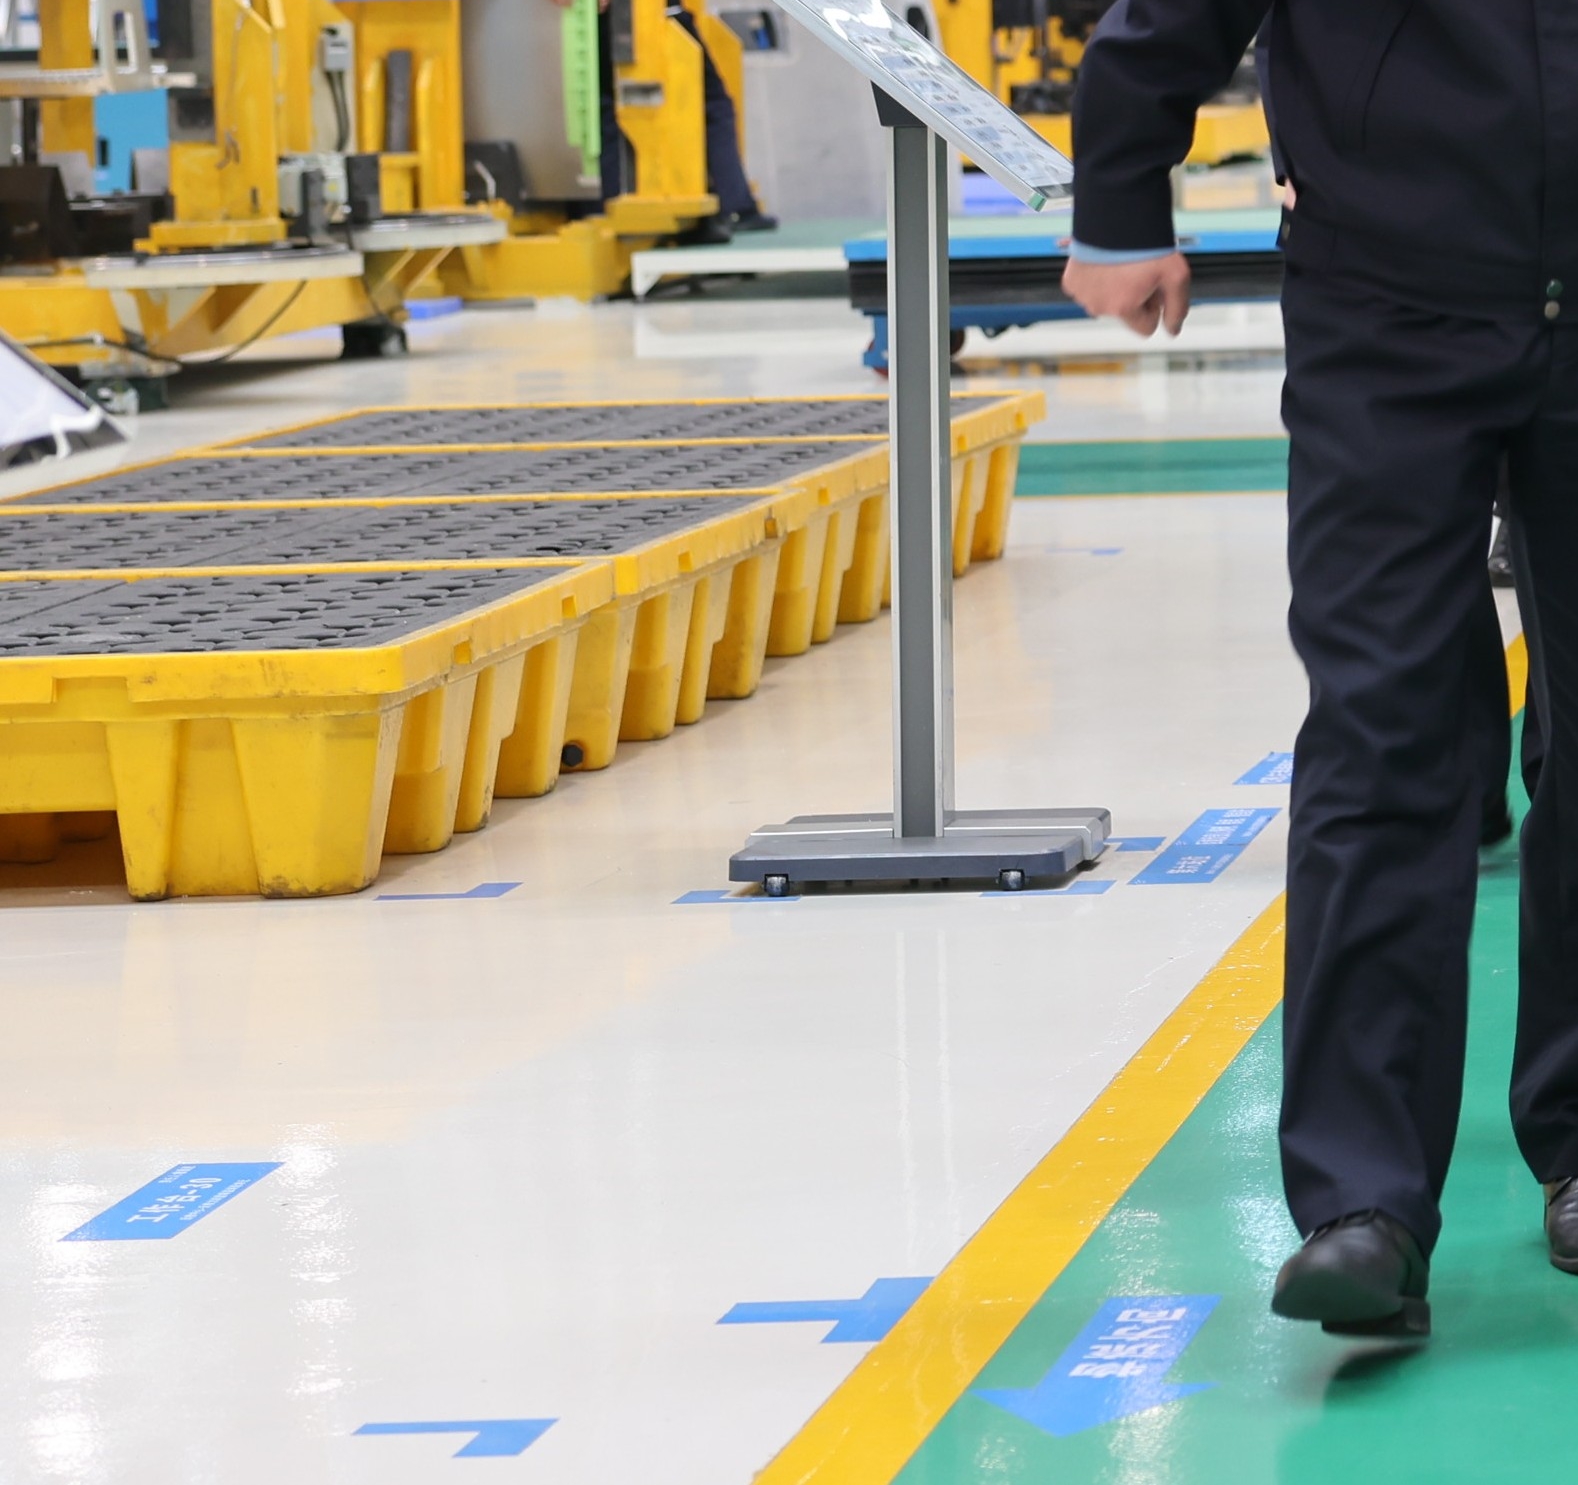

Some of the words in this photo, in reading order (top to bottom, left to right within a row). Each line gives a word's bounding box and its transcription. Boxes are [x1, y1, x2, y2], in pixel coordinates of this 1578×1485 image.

[126, 1177, 222, 1223] 工作台-30
[1068, 1307, 1188, 1378] 物流方向
